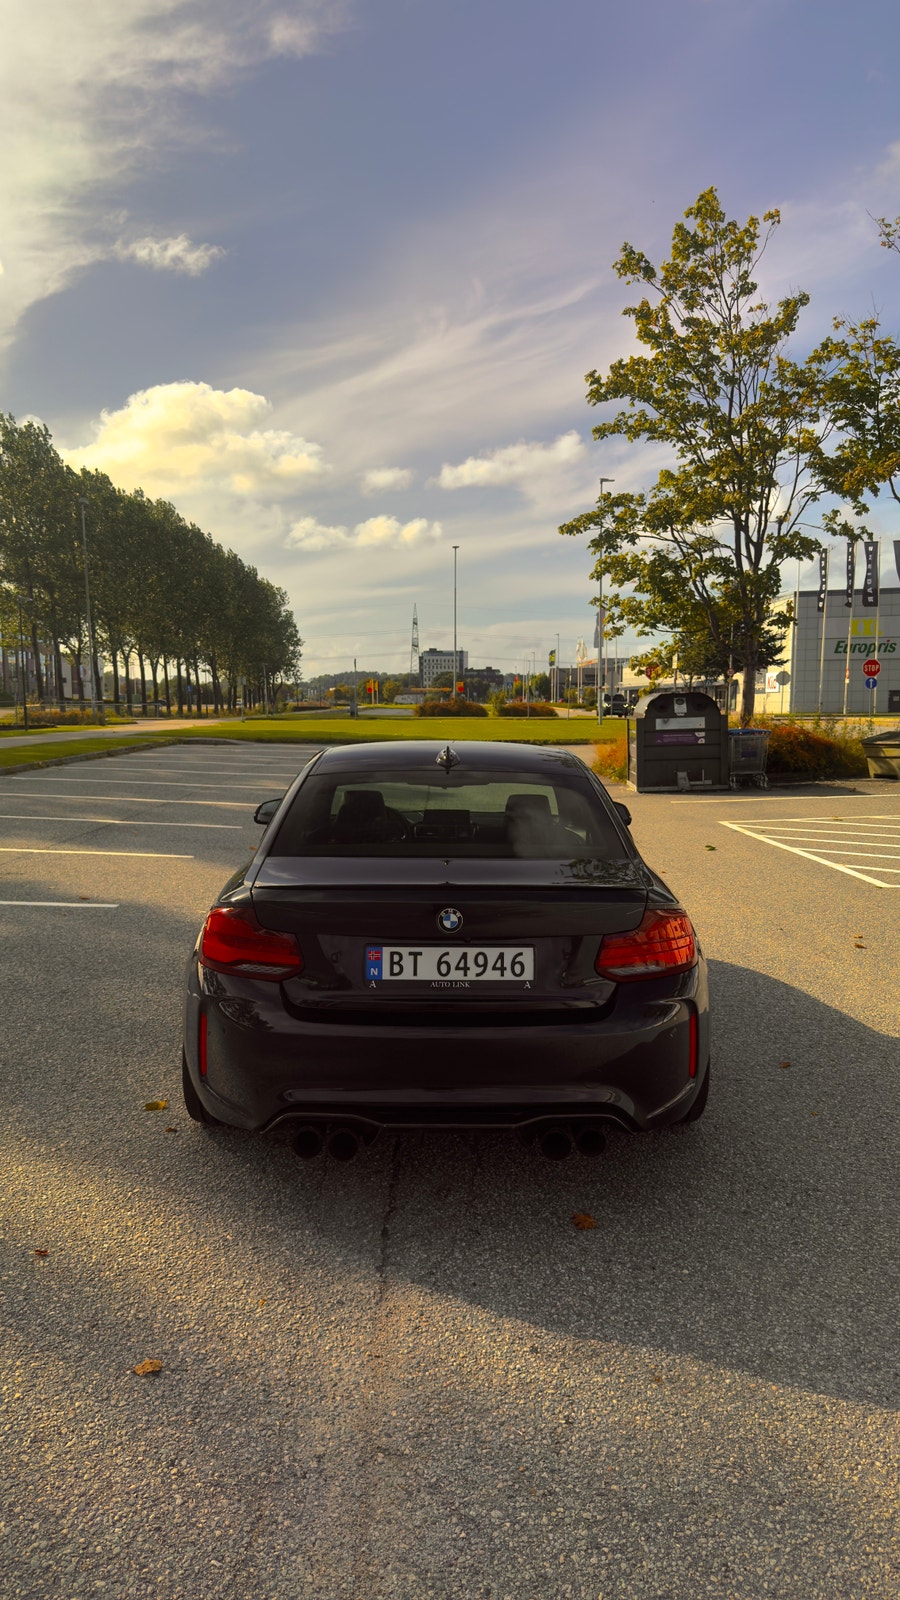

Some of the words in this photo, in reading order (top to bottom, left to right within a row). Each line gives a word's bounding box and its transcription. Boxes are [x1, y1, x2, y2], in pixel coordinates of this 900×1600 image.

[834, 640, 897, 657] Europris
[864, 664, 880, 672] STOP
[389, 951, 423, 977] BT
[436, 951, 526, 977] 64946
[370, 967, 378, 976] N
[369, 980, 377, 988] A
[523, 980, 531, 989] A
